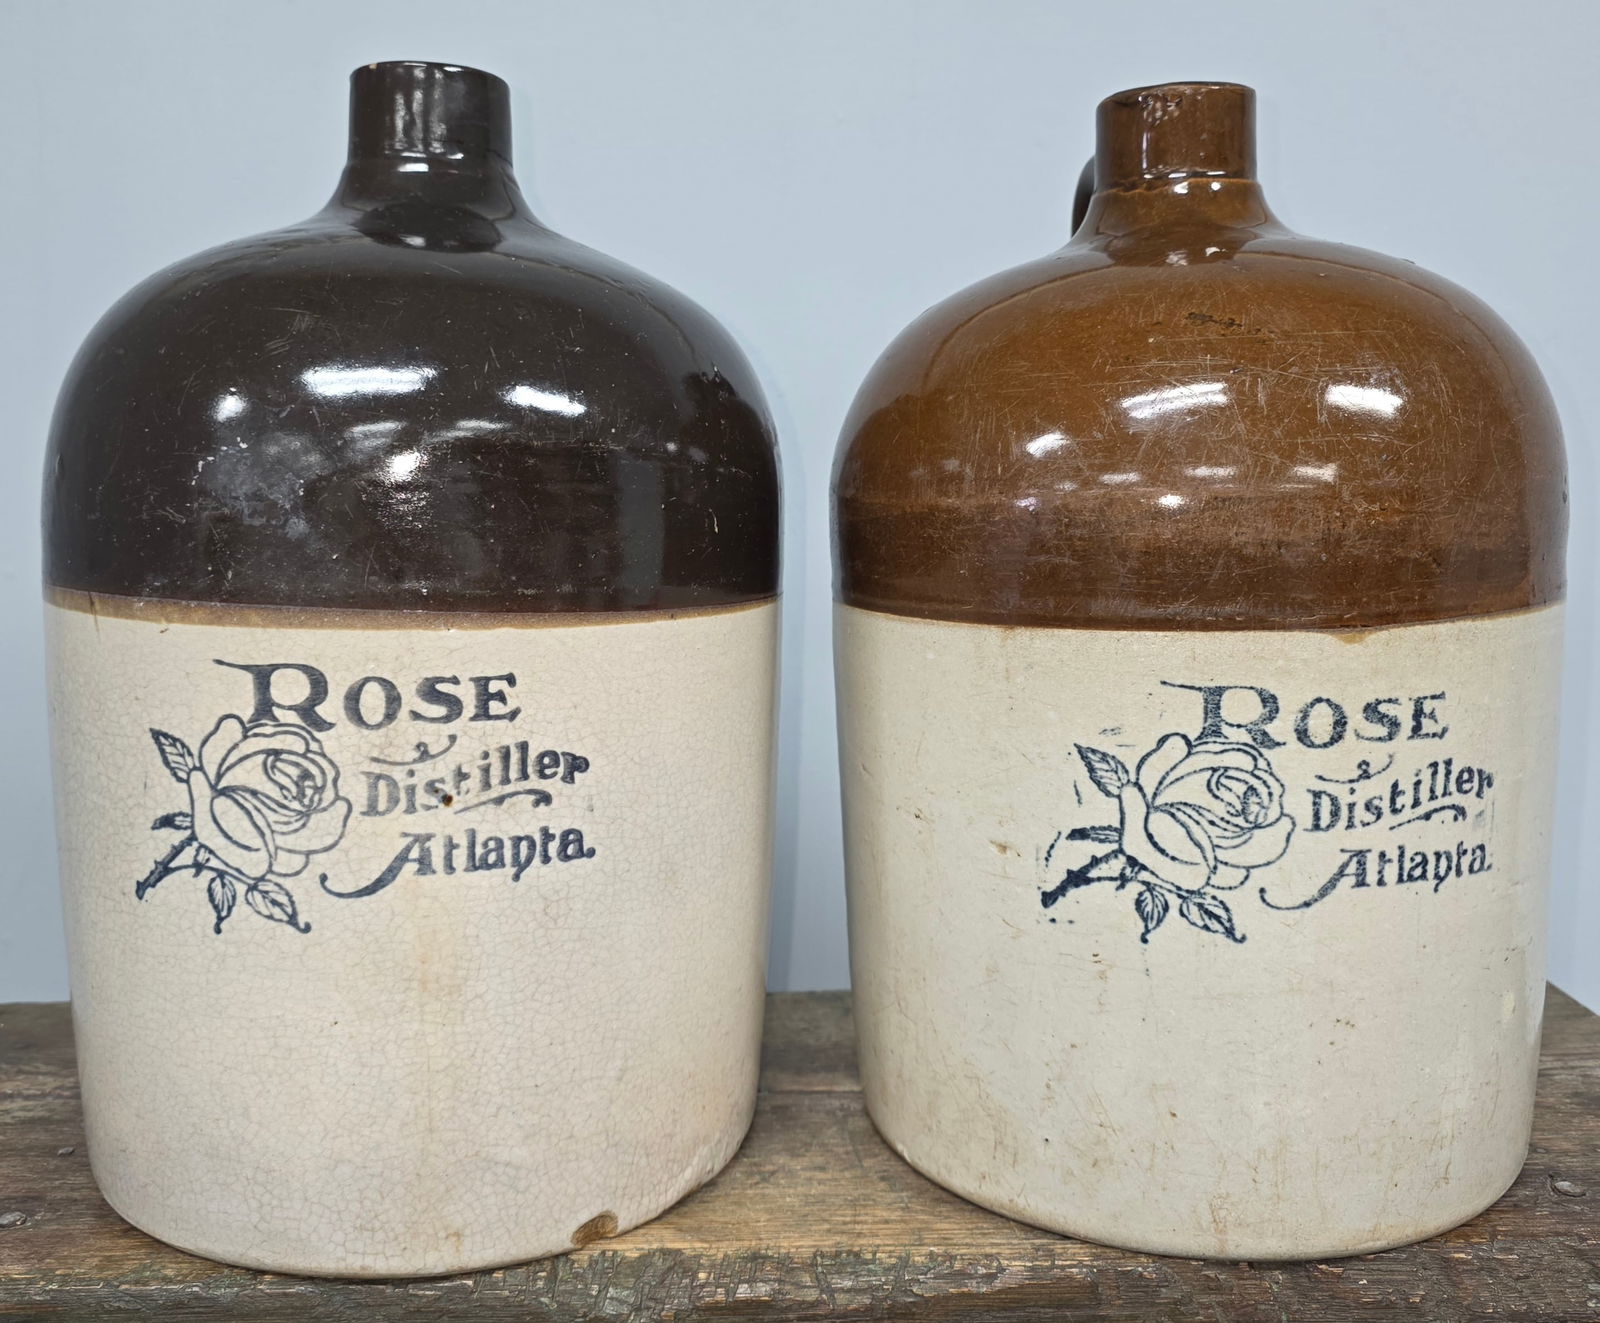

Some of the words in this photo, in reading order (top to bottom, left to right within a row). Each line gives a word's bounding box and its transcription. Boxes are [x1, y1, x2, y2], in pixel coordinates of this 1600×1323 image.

[213, 658, 522, 732] ROSE
[1160, 680, 1450, 750] ROSE
[360, 741, 590, 817] Distiller
[1303, 758, 1495, 832] Distiller
